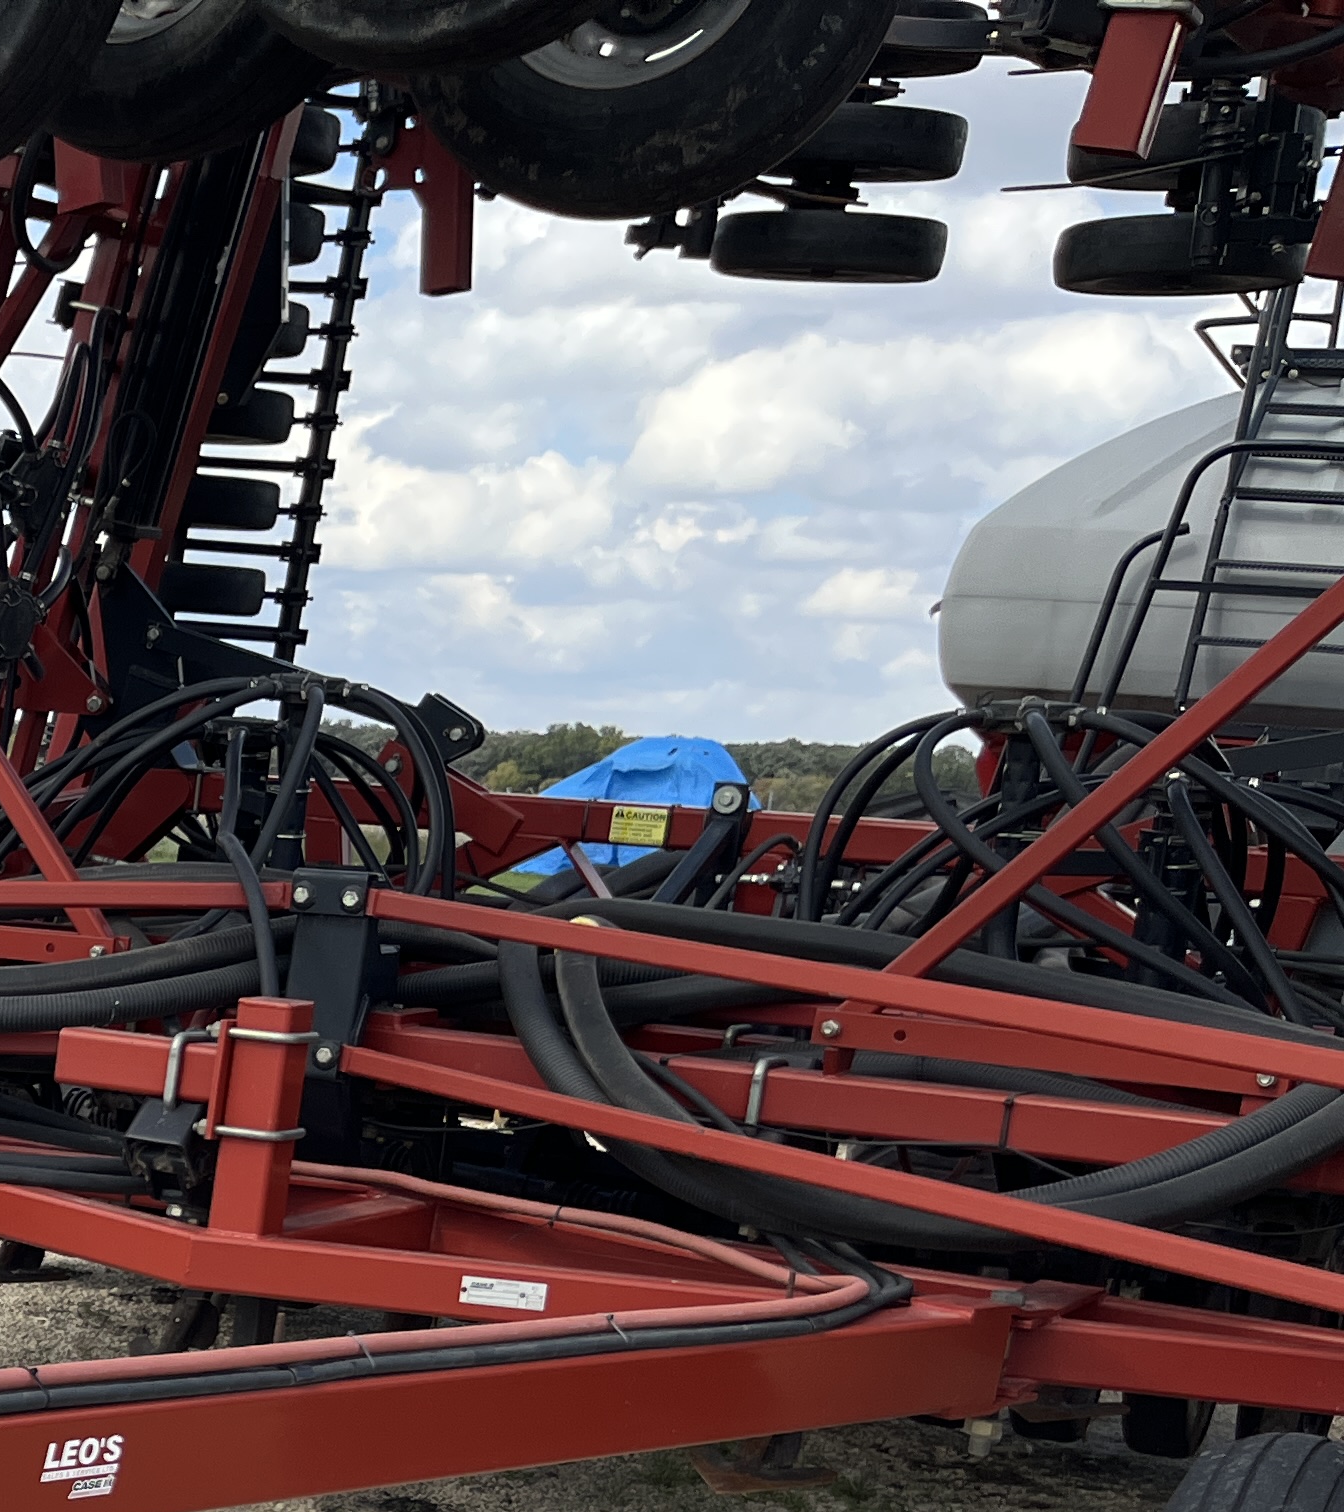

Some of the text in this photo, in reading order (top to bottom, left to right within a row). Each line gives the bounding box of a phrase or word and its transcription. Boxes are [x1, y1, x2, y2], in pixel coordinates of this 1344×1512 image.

[625, 810, 667, 821] CAUTION
[43, 1434, 124, 1470] LEO'S
[73, 1479, 102, 1491] CASE
